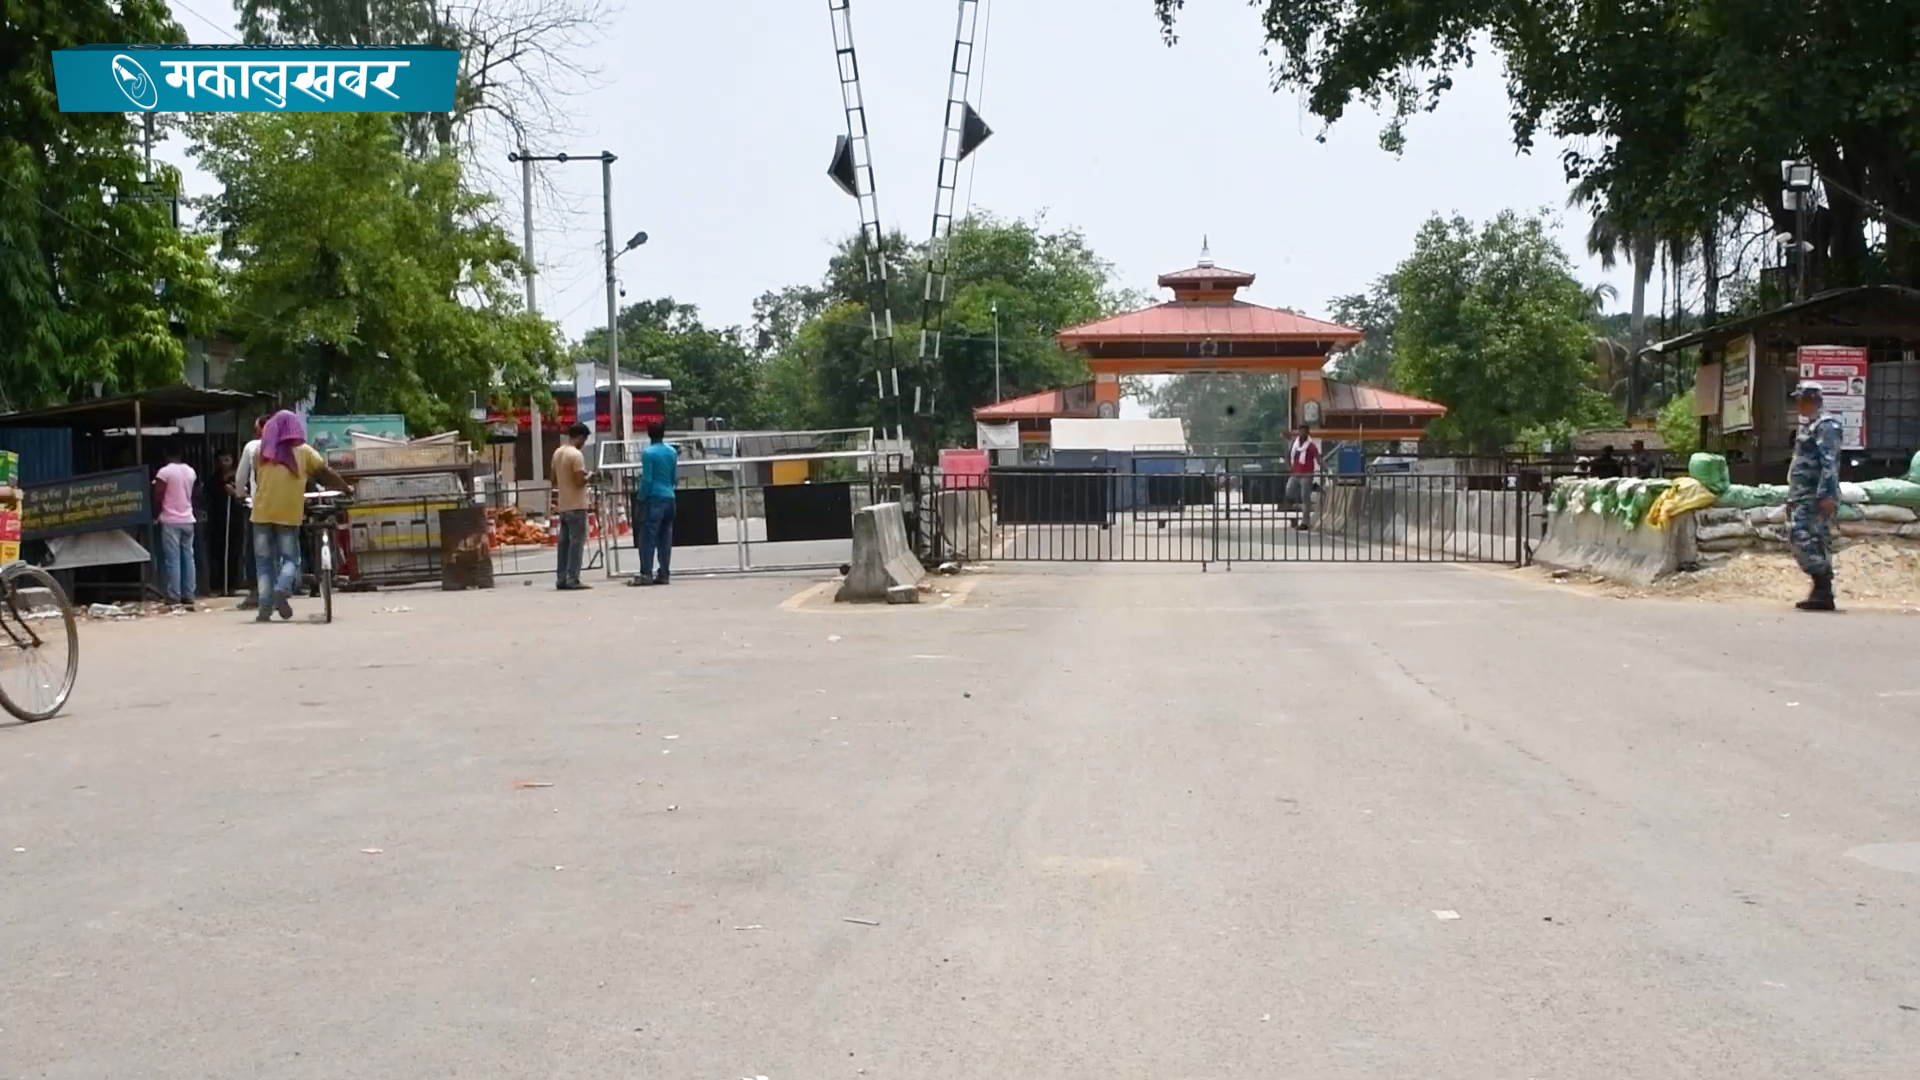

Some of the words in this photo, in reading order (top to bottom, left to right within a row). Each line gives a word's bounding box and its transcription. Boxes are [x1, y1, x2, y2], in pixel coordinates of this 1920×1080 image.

[30, 488, 61, 502] Safe
[69, 481, 118, 498] Journey
[43, 502, 63, 512] You
